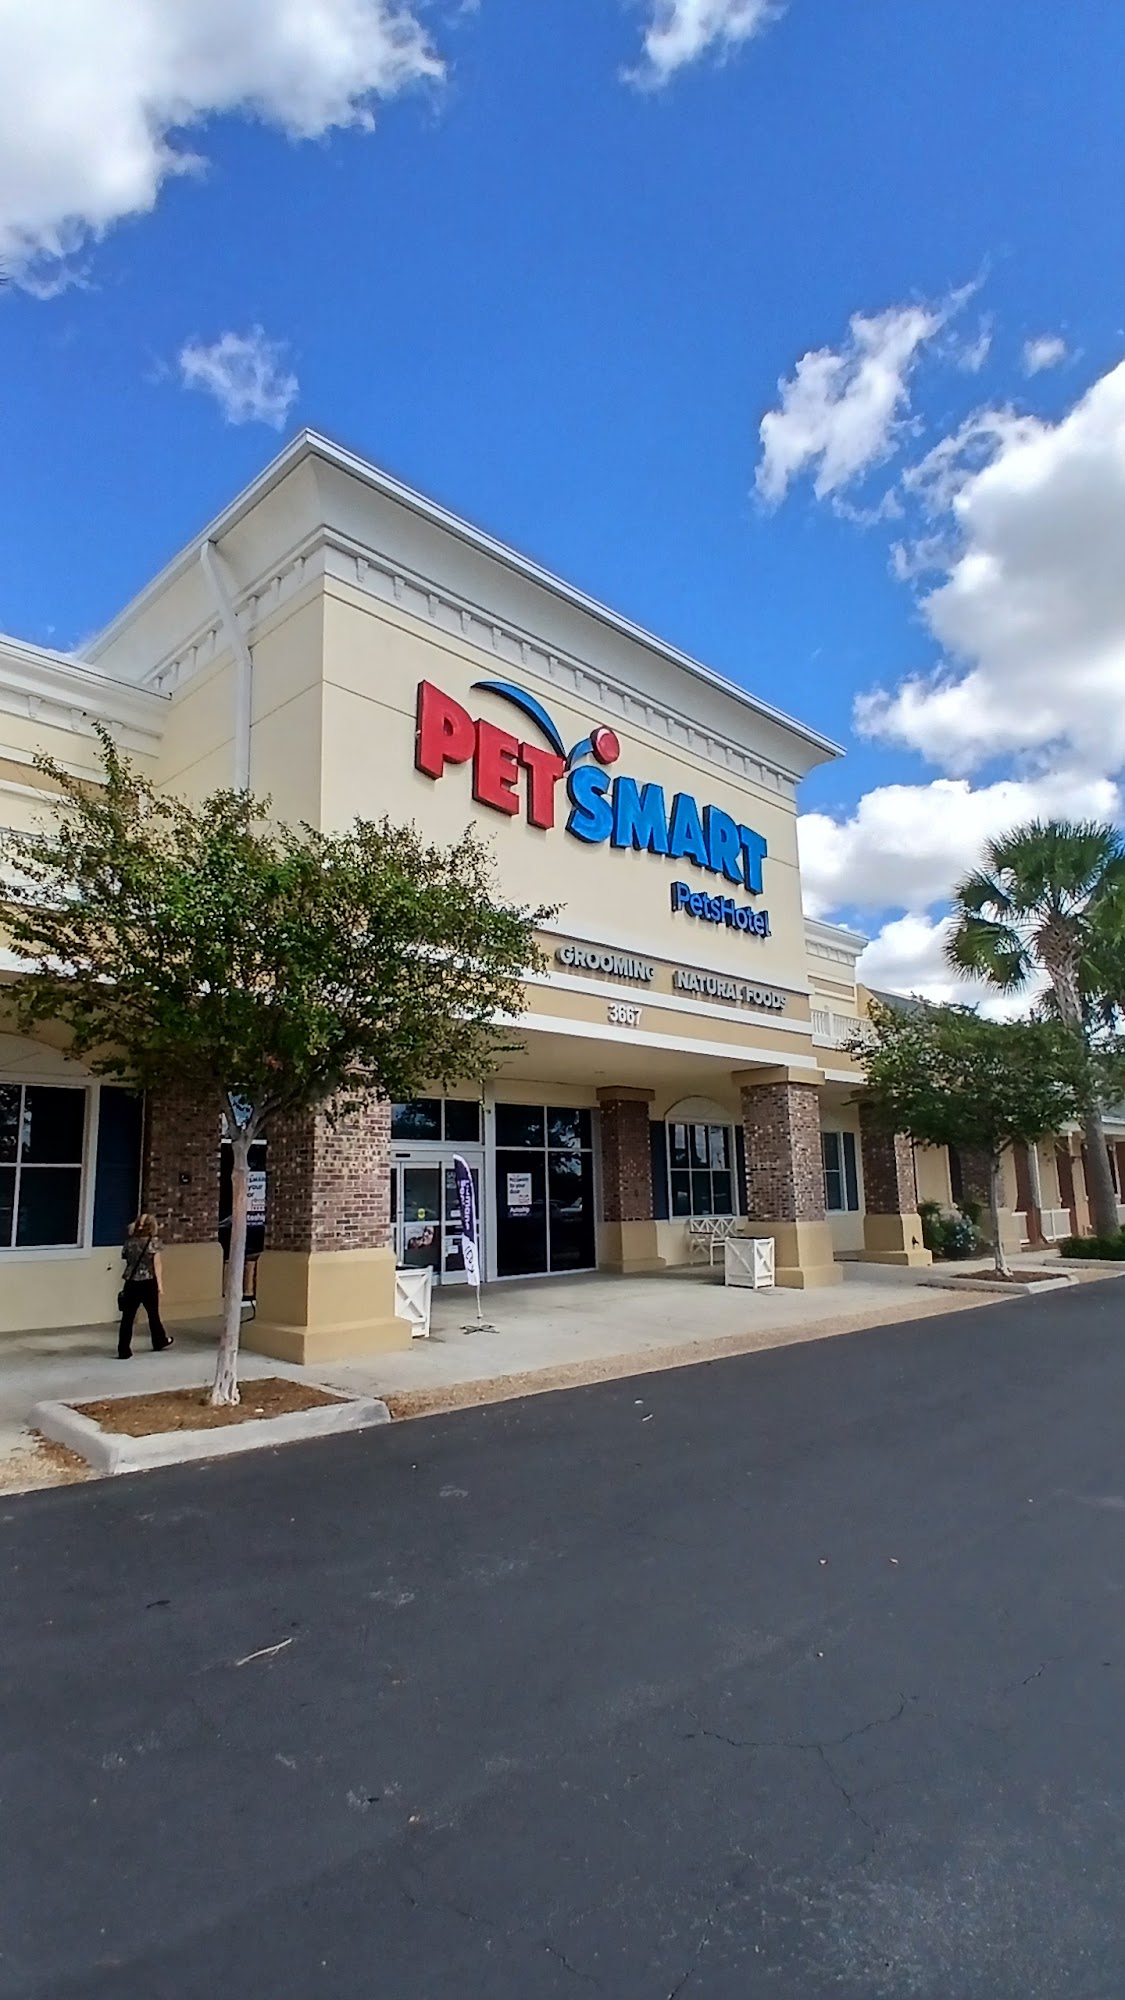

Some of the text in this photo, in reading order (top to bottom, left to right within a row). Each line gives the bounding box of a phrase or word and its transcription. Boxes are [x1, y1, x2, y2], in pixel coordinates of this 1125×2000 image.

[671, 881, 772, 939] PetsHotel
[555, 944, 655, 982] GROOMING
[672, 970, 786, 1010] NATURAL FOODS
[607, 1002, 642, 1026] 3667
